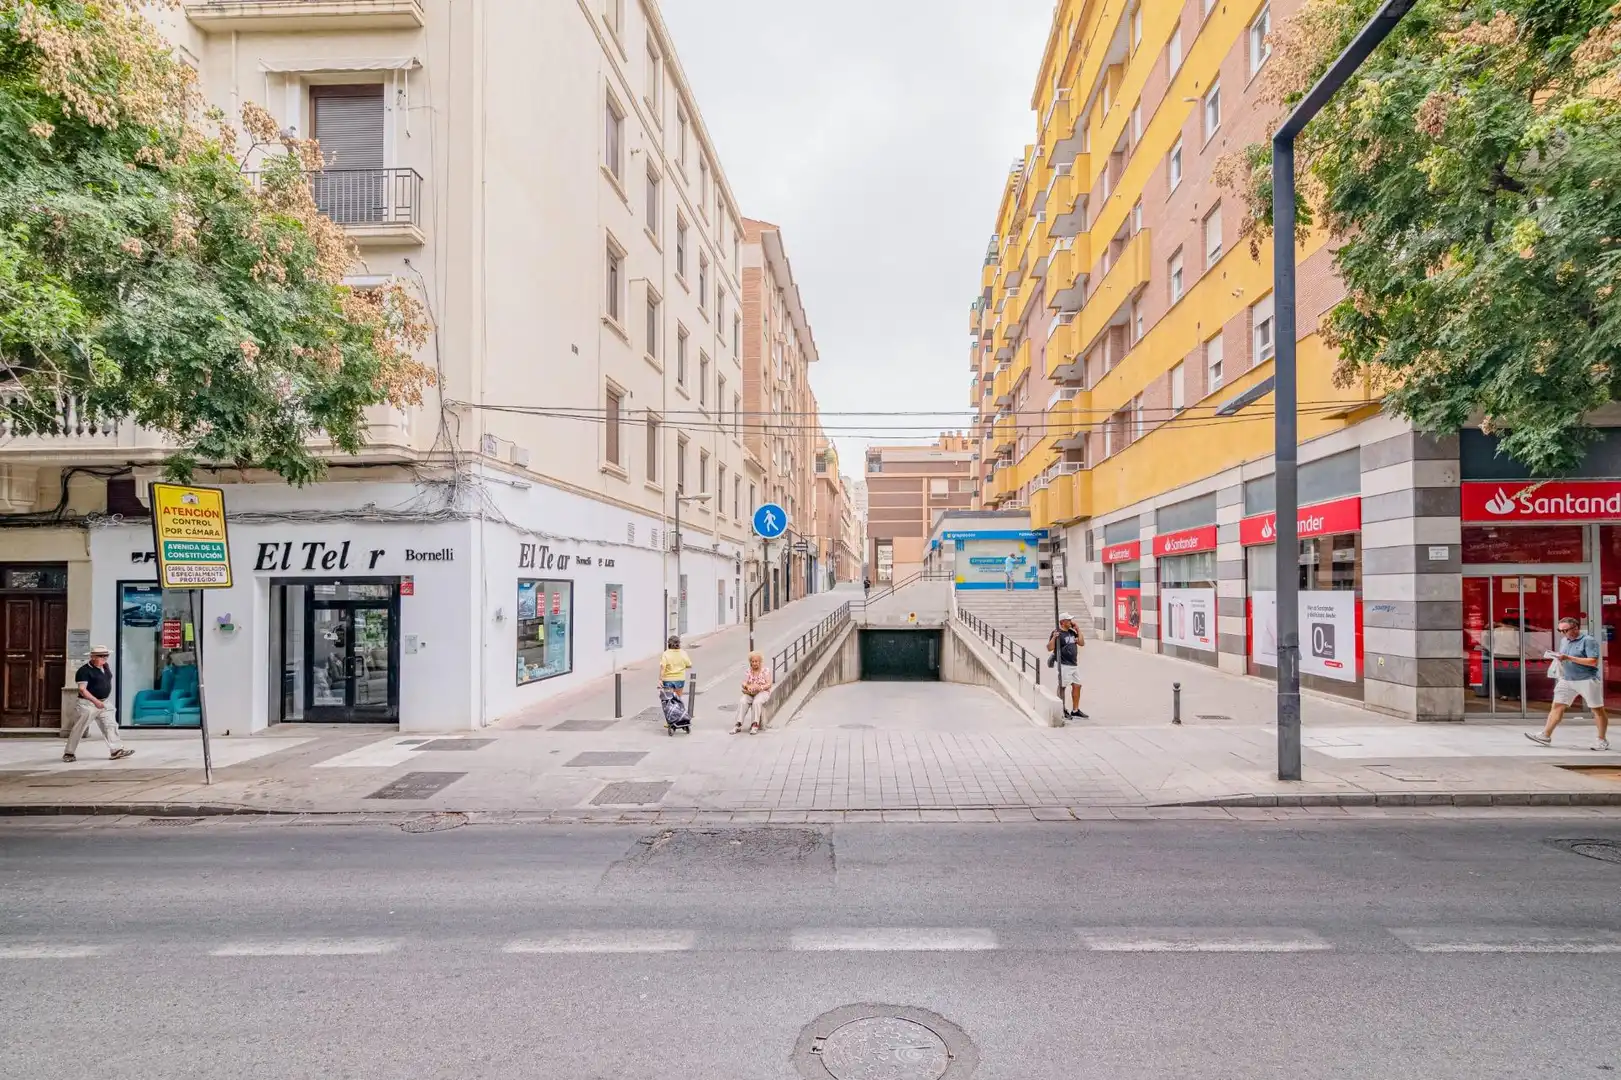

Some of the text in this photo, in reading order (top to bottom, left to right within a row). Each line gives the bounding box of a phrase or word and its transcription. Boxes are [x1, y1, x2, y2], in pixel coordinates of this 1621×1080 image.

[163, 506, 220, 519] ATENCIÓN
[172, 517, 212, 527] CONTROL
[165, 527, 220, 537] POR CÁMARA
[167, 543, 200, 551] AVENIDA
[1170, 536, 1199, 551] Santander
[168, 551, 223, 559] CONSTITUCIÓN
[253, 541, 292, 571] El
[405, 548, 454, 562] Bornelli
[518, 542, 537, 569] El
